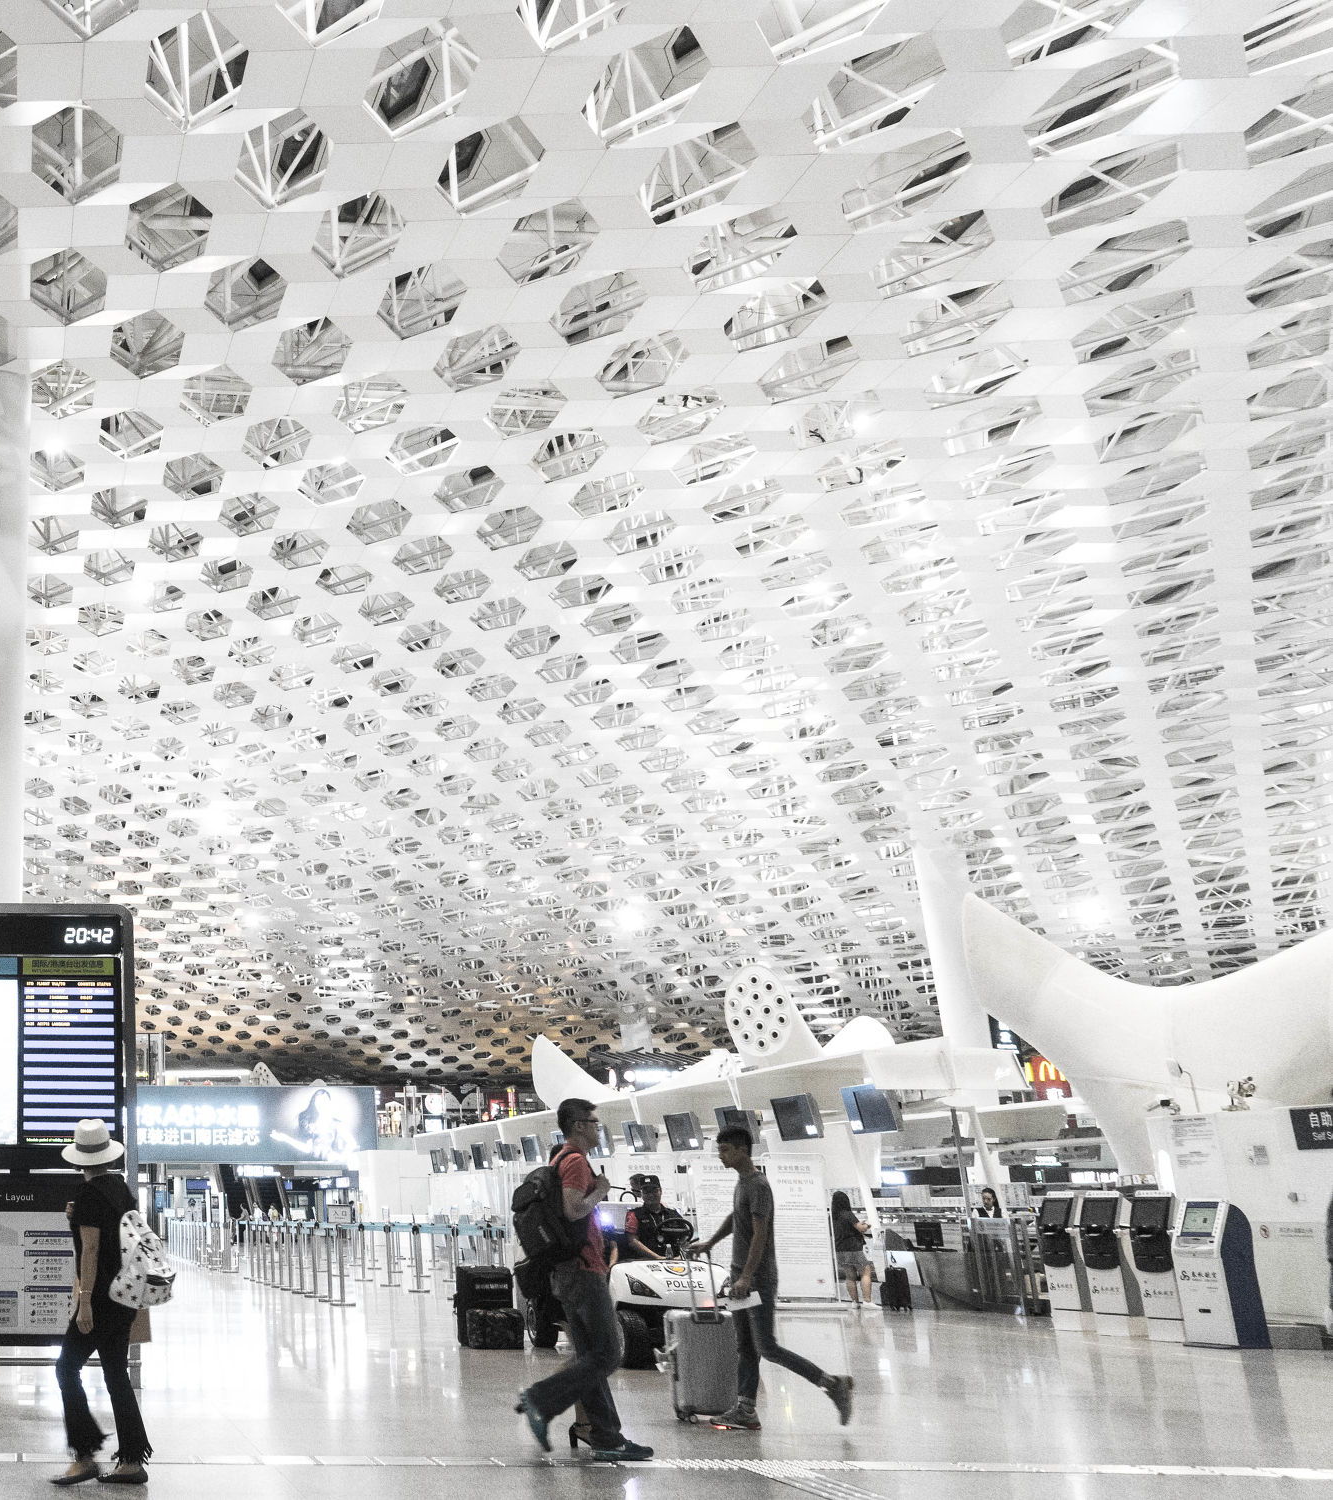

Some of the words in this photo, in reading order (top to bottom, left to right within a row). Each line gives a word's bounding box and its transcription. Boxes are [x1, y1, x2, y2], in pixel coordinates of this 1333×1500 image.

[64, 927, 114, 944] 20:42
[5, 1194, 34, 1202] Layout
[667, 1280, 704, 1289] POLICE
